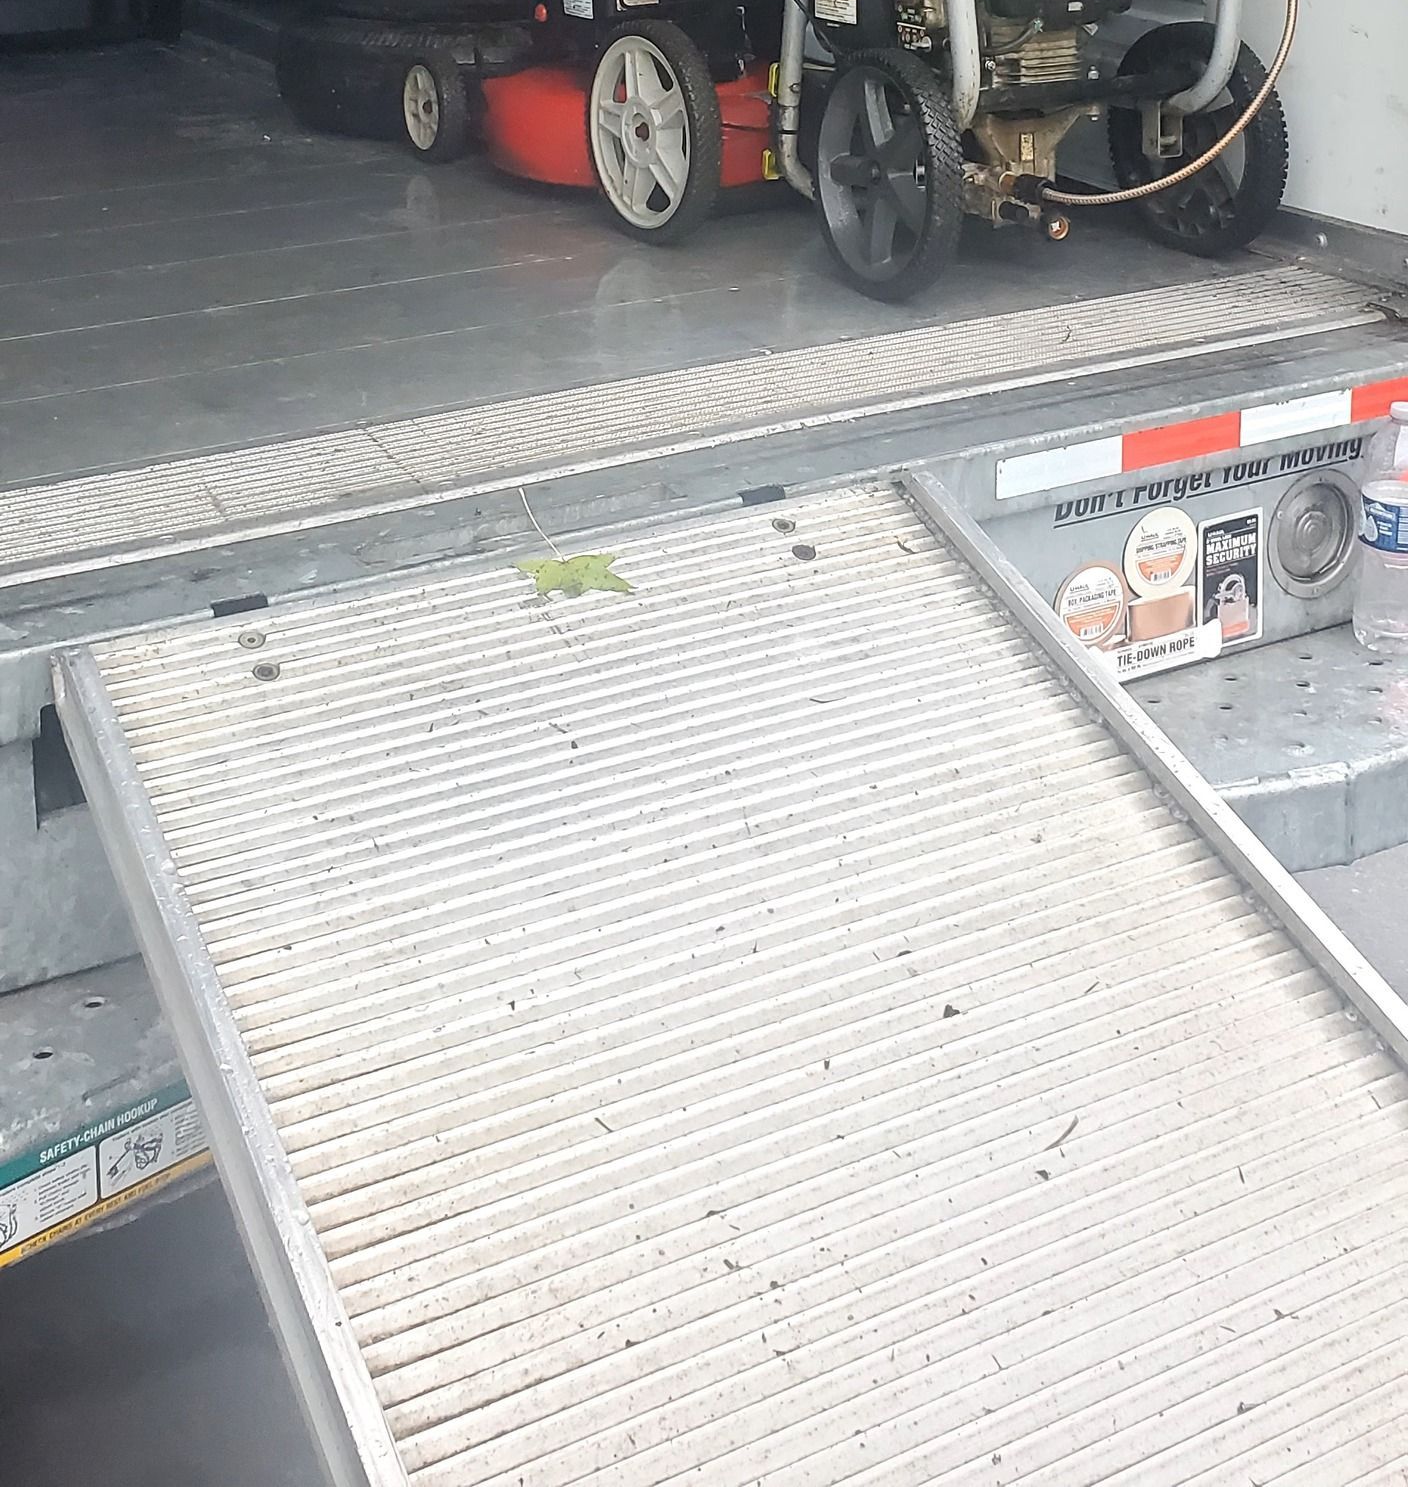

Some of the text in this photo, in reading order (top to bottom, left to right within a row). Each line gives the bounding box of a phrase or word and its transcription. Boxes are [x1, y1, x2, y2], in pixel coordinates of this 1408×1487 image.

[1054, 437, 1362, 522] Don't Forget Your Moving
[1205, 543, 1257, 566] SECURITY
[1206, 532, 1257, 555] MAXIMUM
[1117, 636, 1195, 667] TIE-DOWN ROPE
[39, 1118, 115, 1163] SAFETY-CHAIN
[116, 1098, 158, 1126] HOOKUP
